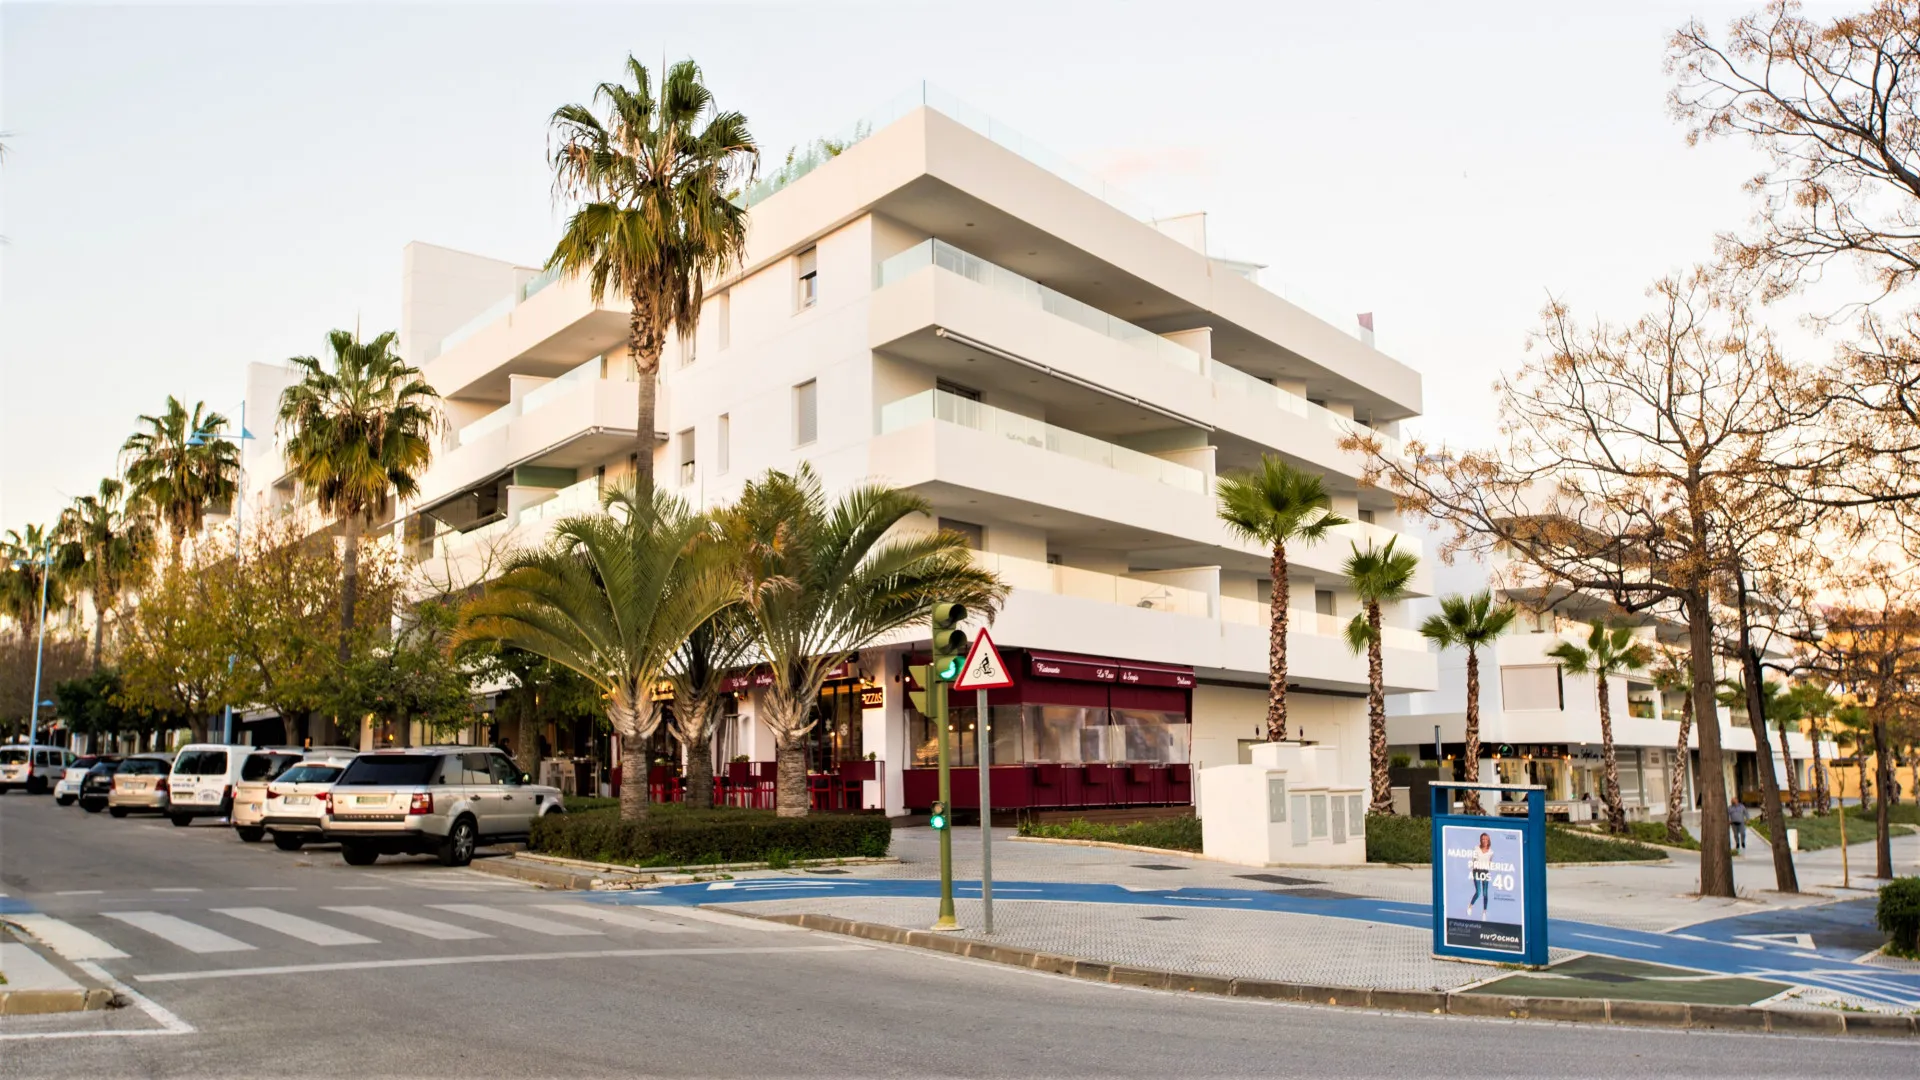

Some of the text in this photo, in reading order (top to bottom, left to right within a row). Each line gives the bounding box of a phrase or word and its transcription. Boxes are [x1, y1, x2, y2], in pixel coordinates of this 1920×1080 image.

[1447, 848, 1479, 858] MADRE
[1467, 861, 1515, 872] PRIMERIZA
[1468, 872, 1514, 891] A LOS 40
